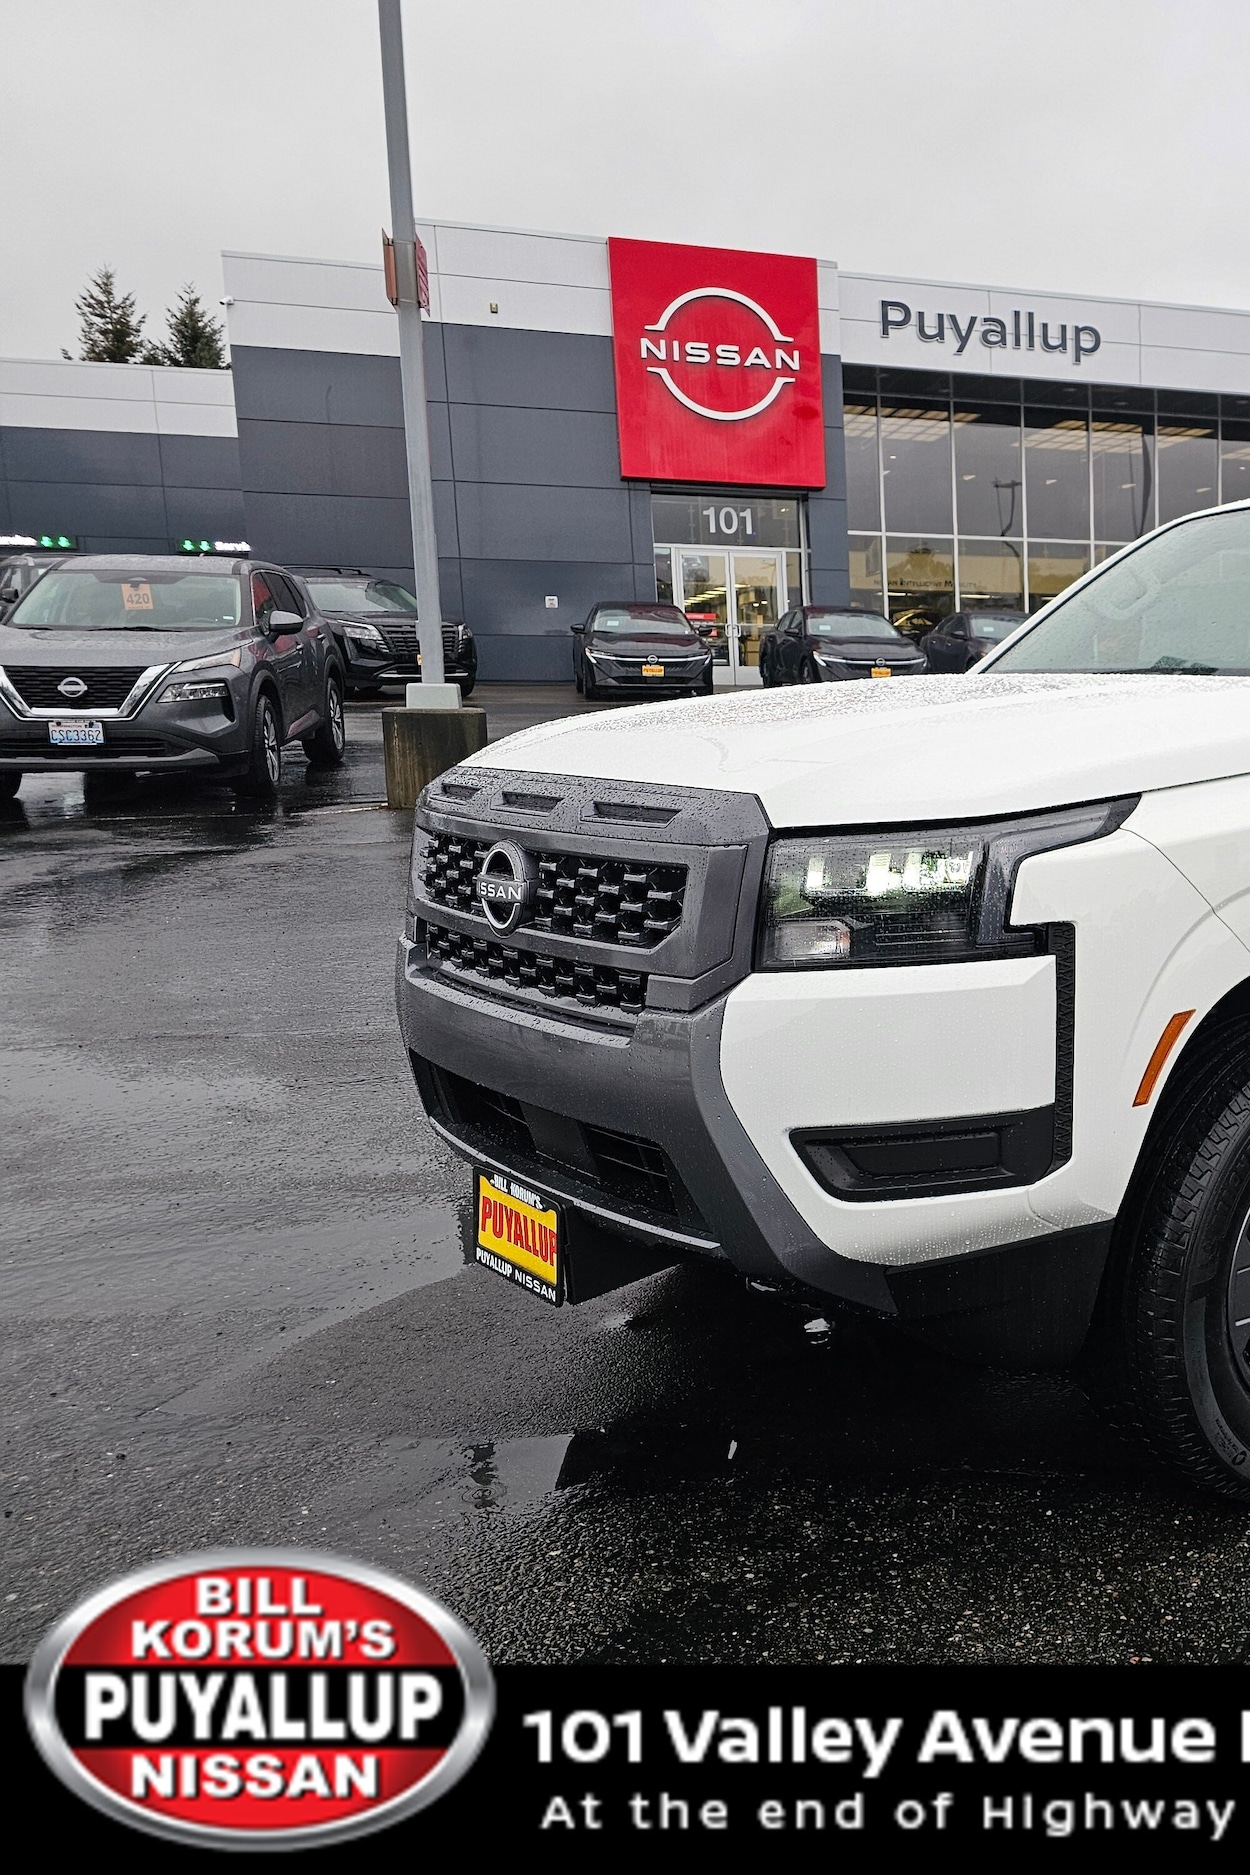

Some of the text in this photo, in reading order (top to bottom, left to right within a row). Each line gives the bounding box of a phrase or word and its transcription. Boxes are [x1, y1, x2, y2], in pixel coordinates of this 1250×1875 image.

[880, 299, 1101, 365] Puyallup
[640, 337, 800, 371] NISSAN
[702, 506, 754, 536] 101
[127, 593, 150, 605] 420
[50, 729, 103, 742] CSC3362
[493, 1173, 544, 1210] BILL KORUM'S
[480, 1195, 558, 1267] PUYALLUP
[475, 1247, 557, 1303] PUYALLUP NISSAN
